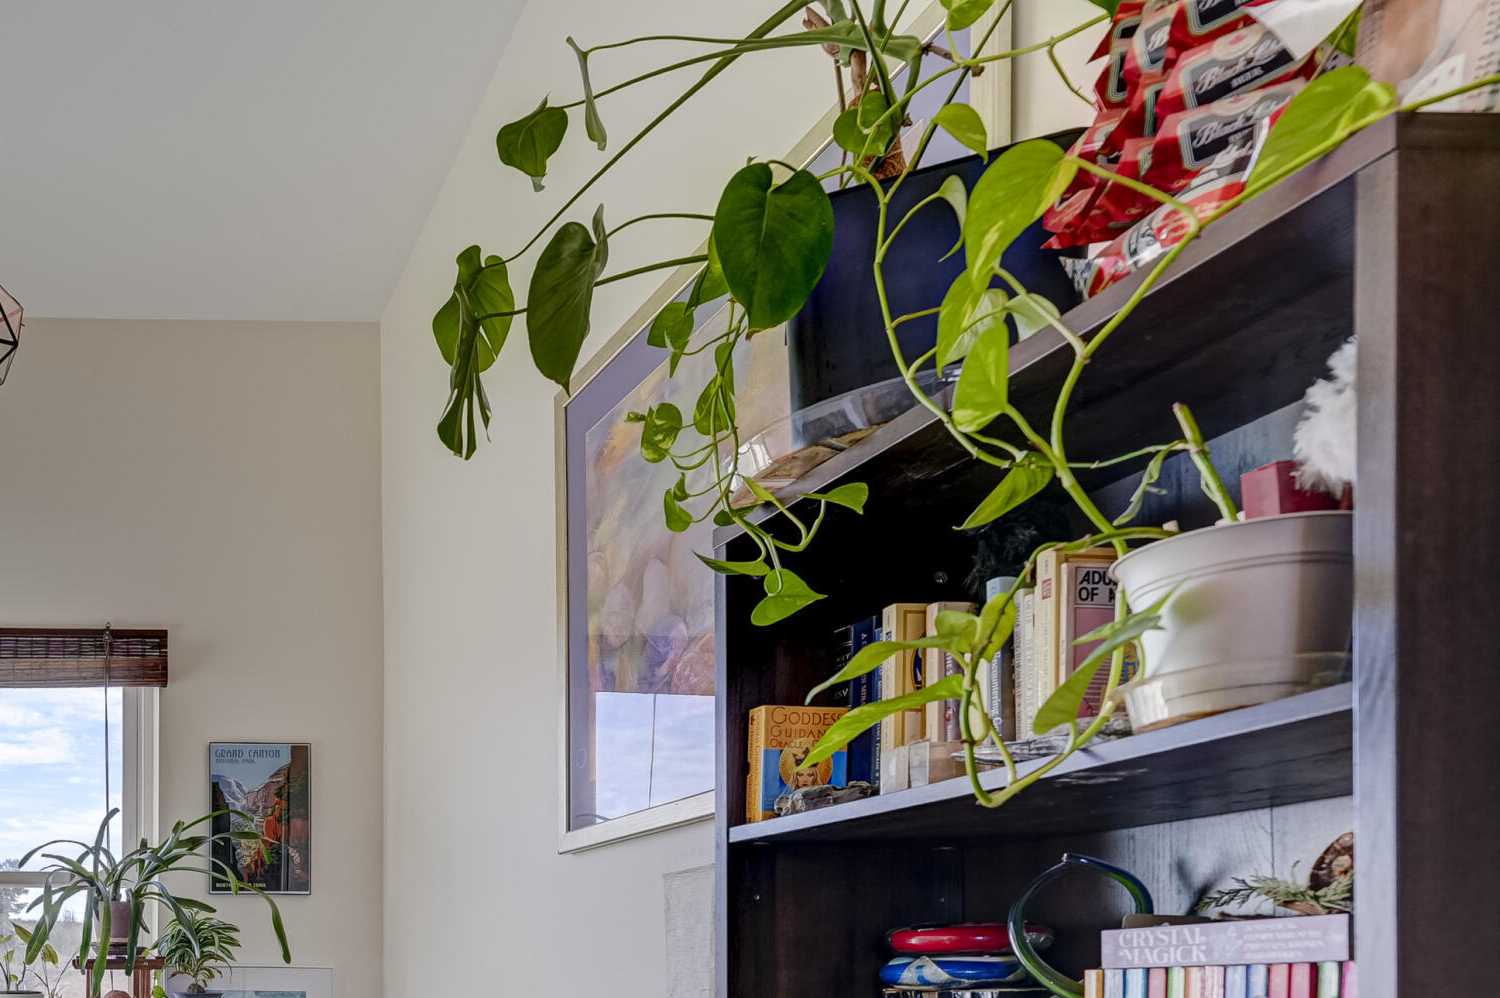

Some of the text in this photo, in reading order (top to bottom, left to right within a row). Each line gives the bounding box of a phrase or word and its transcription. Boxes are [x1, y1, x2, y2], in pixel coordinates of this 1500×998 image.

[1078, 570, 1116, 586] ADU
[1078, 586, 1099, 601] OF
[770, 725, 827, 739] GUIDAN
[215, 749, 280, 759] GRAND CANYON
[1118, 927, 1207, 948] CRYSTAL
[1118, 945, 1207, 965] MAGICK
